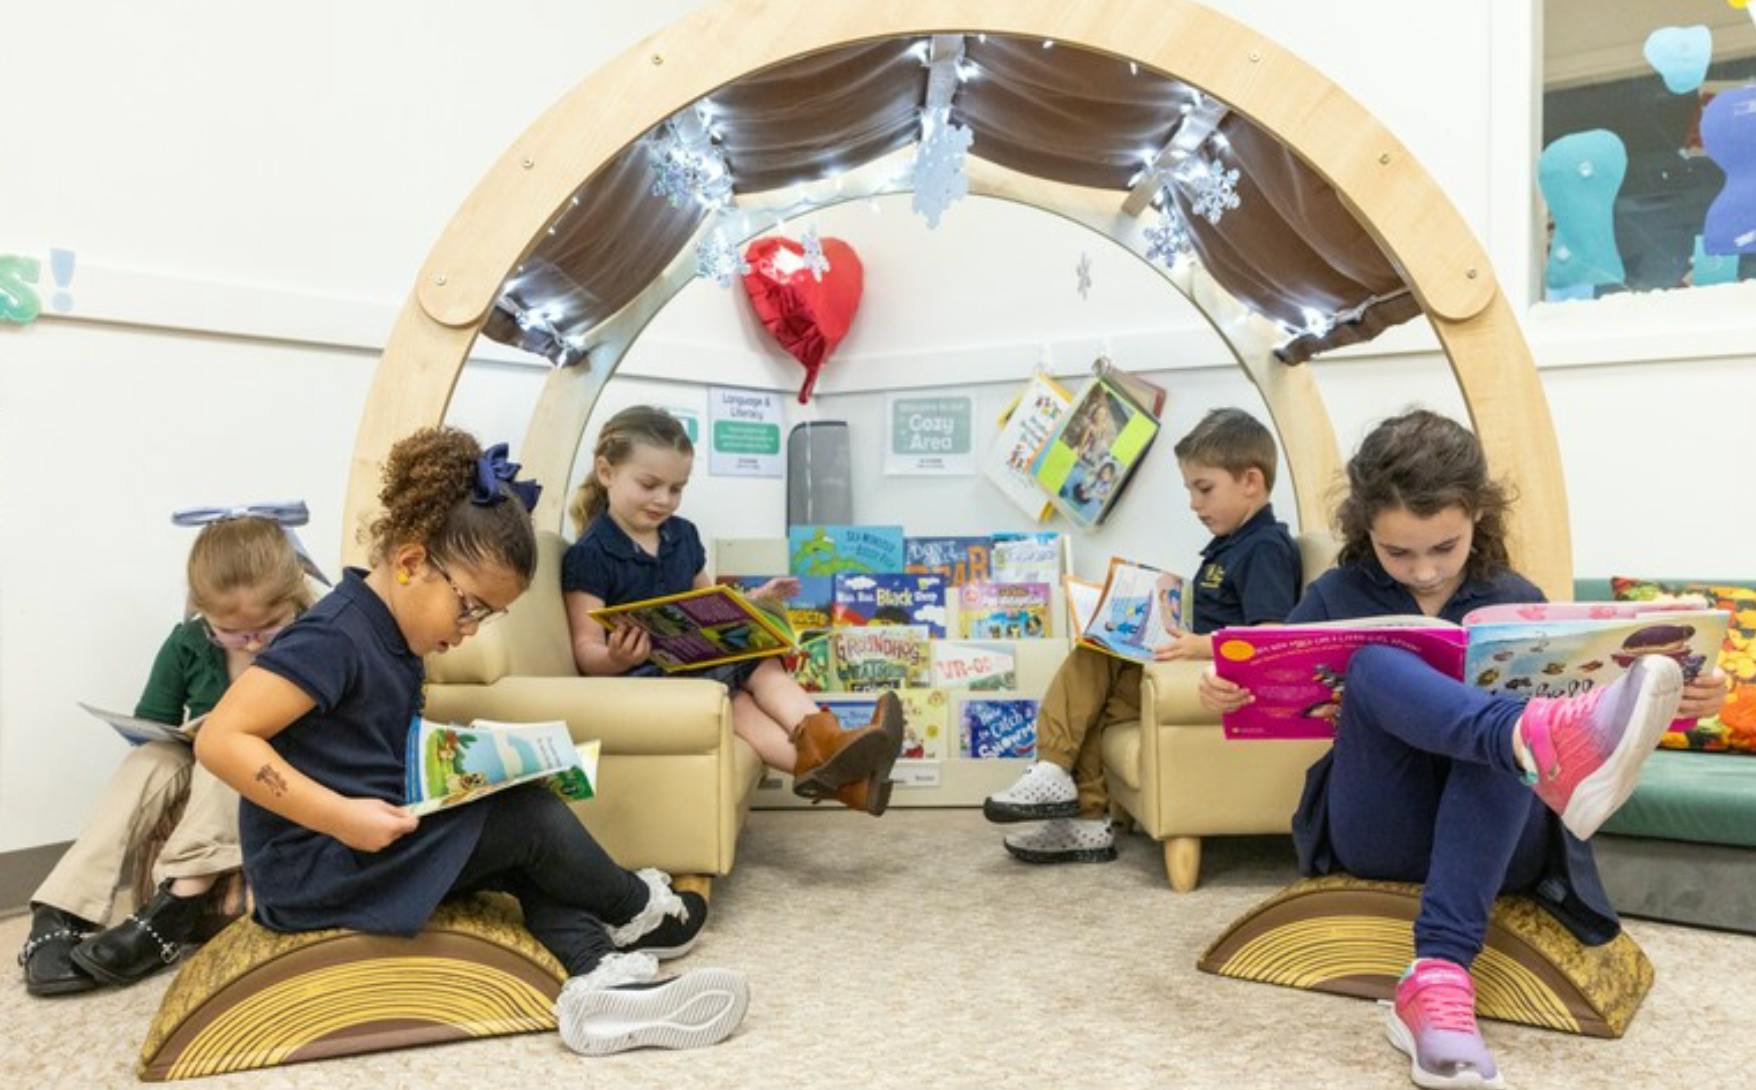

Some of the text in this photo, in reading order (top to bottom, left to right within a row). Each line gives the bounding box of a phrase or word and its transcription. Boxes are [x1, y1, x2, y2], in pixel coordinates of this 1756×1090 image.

[723, 392, 771, 408] Language &
[730, 407, 764, 421] Literacy
[909, 413, 954, 436] Cozy
[909, 431, 952, 450] Area
[876, 587, 913, 607] Black
